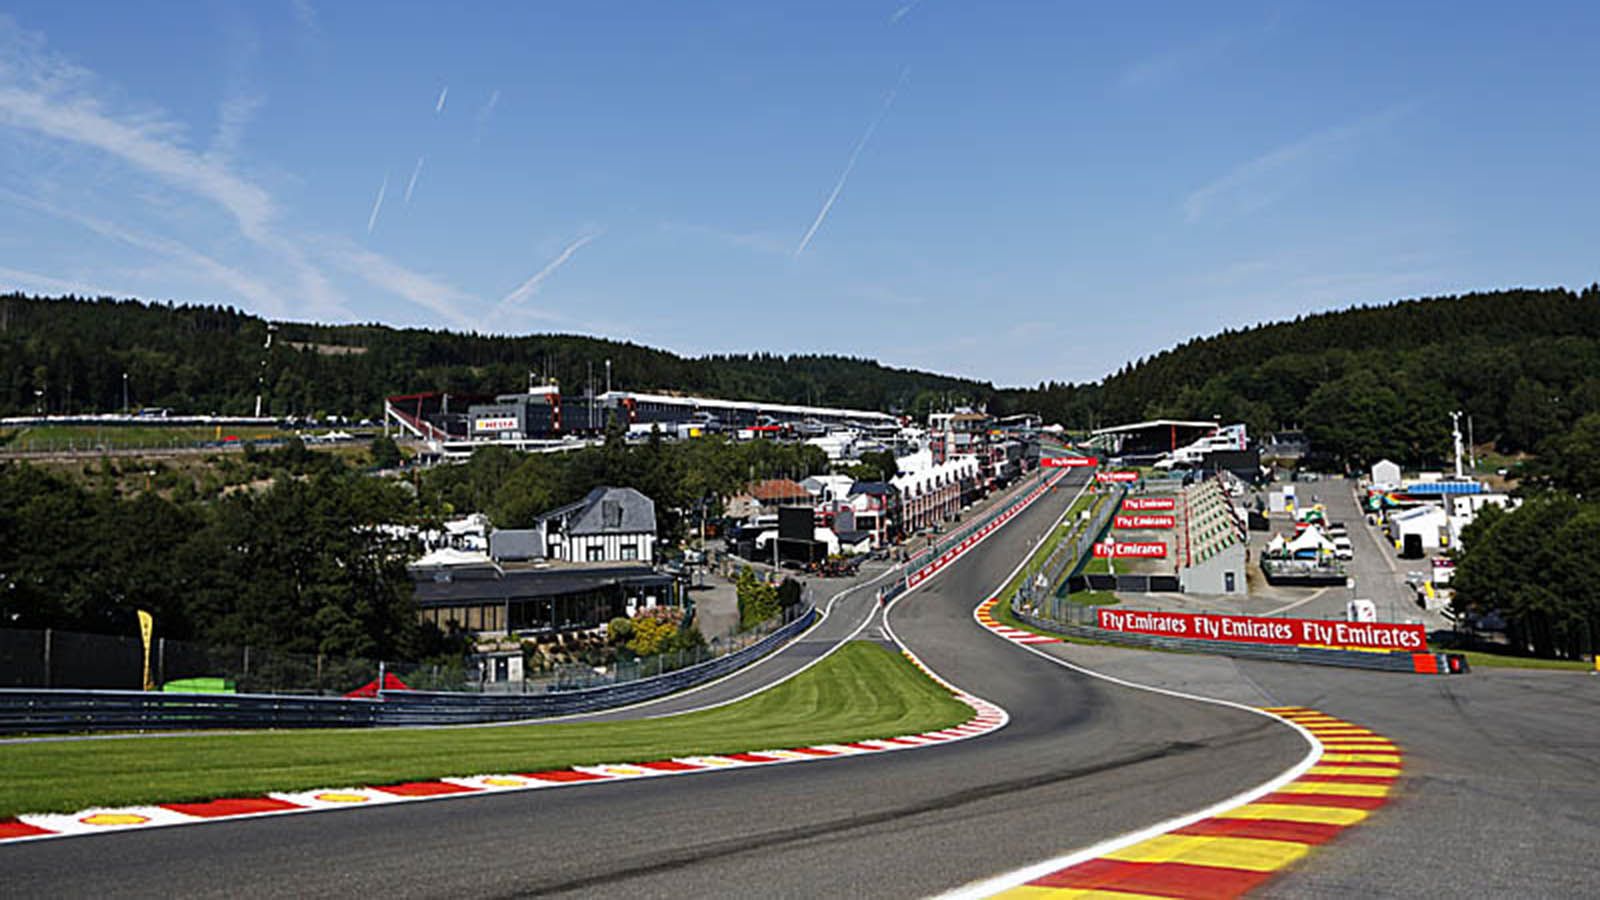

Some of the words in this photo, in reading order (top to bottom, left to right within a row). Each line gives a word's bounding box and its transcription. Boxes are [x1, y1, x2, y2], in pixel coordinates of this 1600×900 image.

[1096, 544, 1114, 556] Fly
[1116, 544, 1164, 555] Emirates
[1101, 611, 1124, 632] Fly
[1126, 613, 1188, 633] Emirates
[1193, 616, 1219, 639] Fly
[1222, 617, 1293, 640] Emirates
[1302, 622, 1332, 645] Fly
[1336, 623, 1421, 648] Emirates
